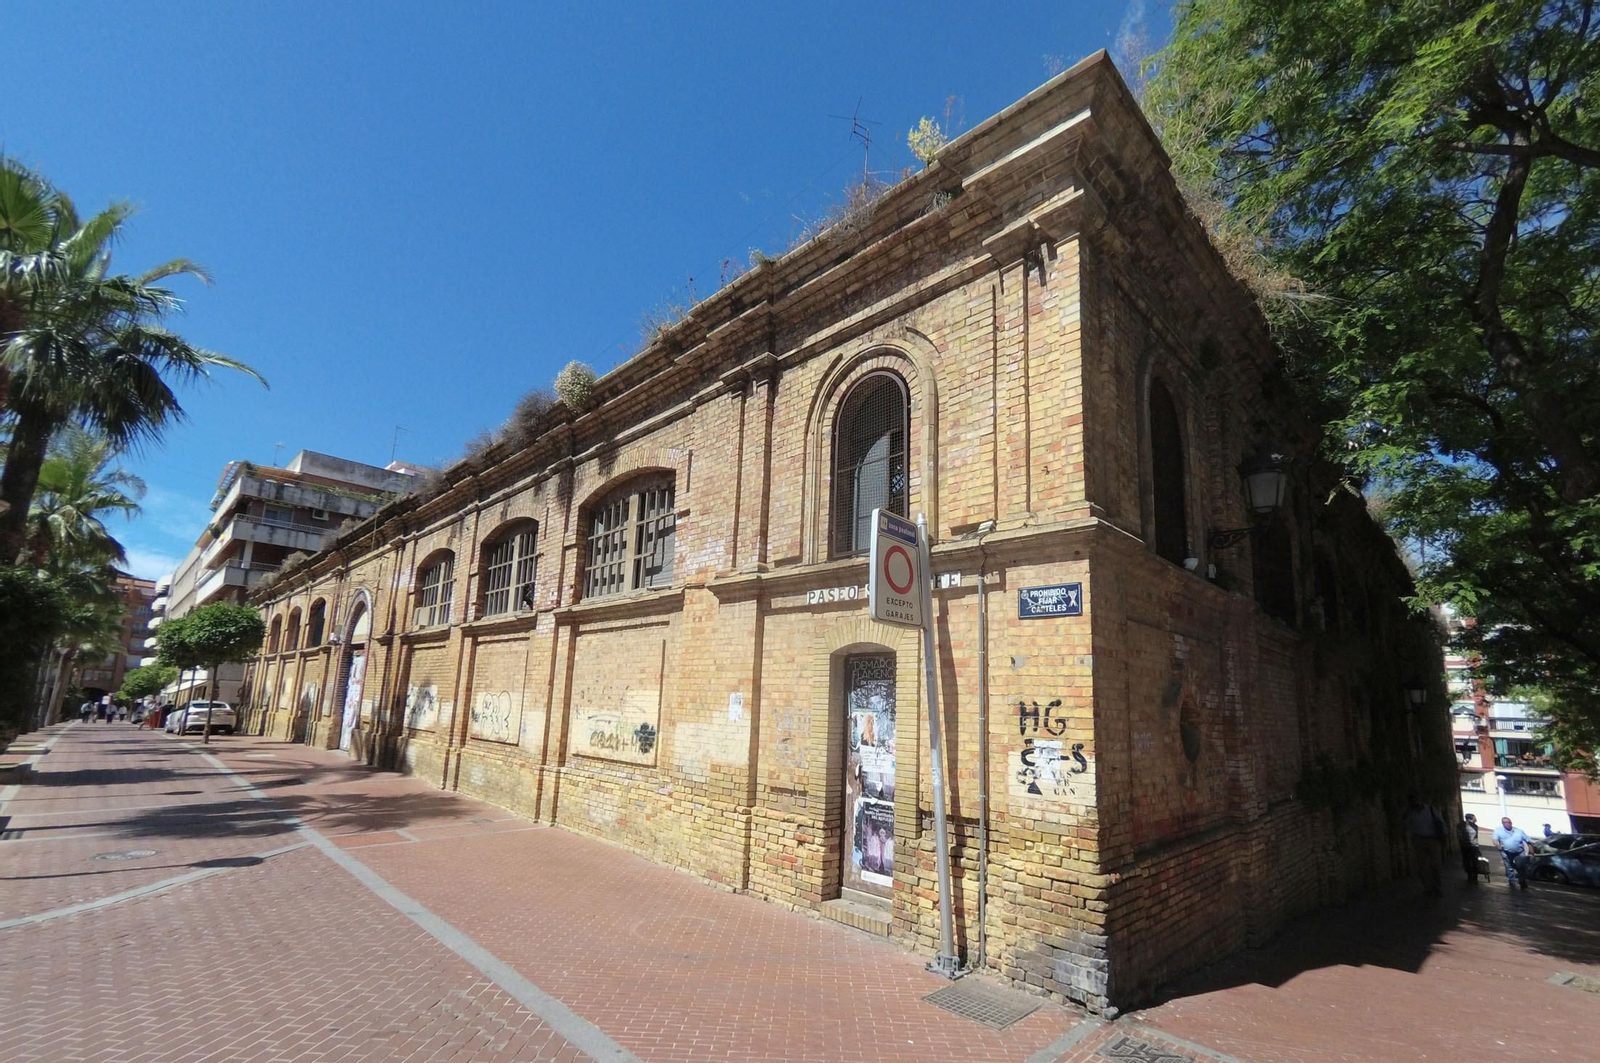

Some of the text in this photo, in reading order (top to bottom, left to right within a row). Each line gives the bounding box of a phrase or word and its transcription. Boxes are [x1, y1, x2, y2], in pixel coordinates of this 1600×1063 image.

[808, 587, 857, 604] PASEO
[1030, 588, 1066, 598] PROHIBIDO
[886, 597, 913, 609] EXCEPTO
[1038, 597, 1058, 605] FIJAR
[1031, 604, 1067, 613] CARTELES
[885, 609, 914, 621] GARAJES
[852, 668, 896, 679] FLAMENC
[1053, 787, 1077, 796] CAN
